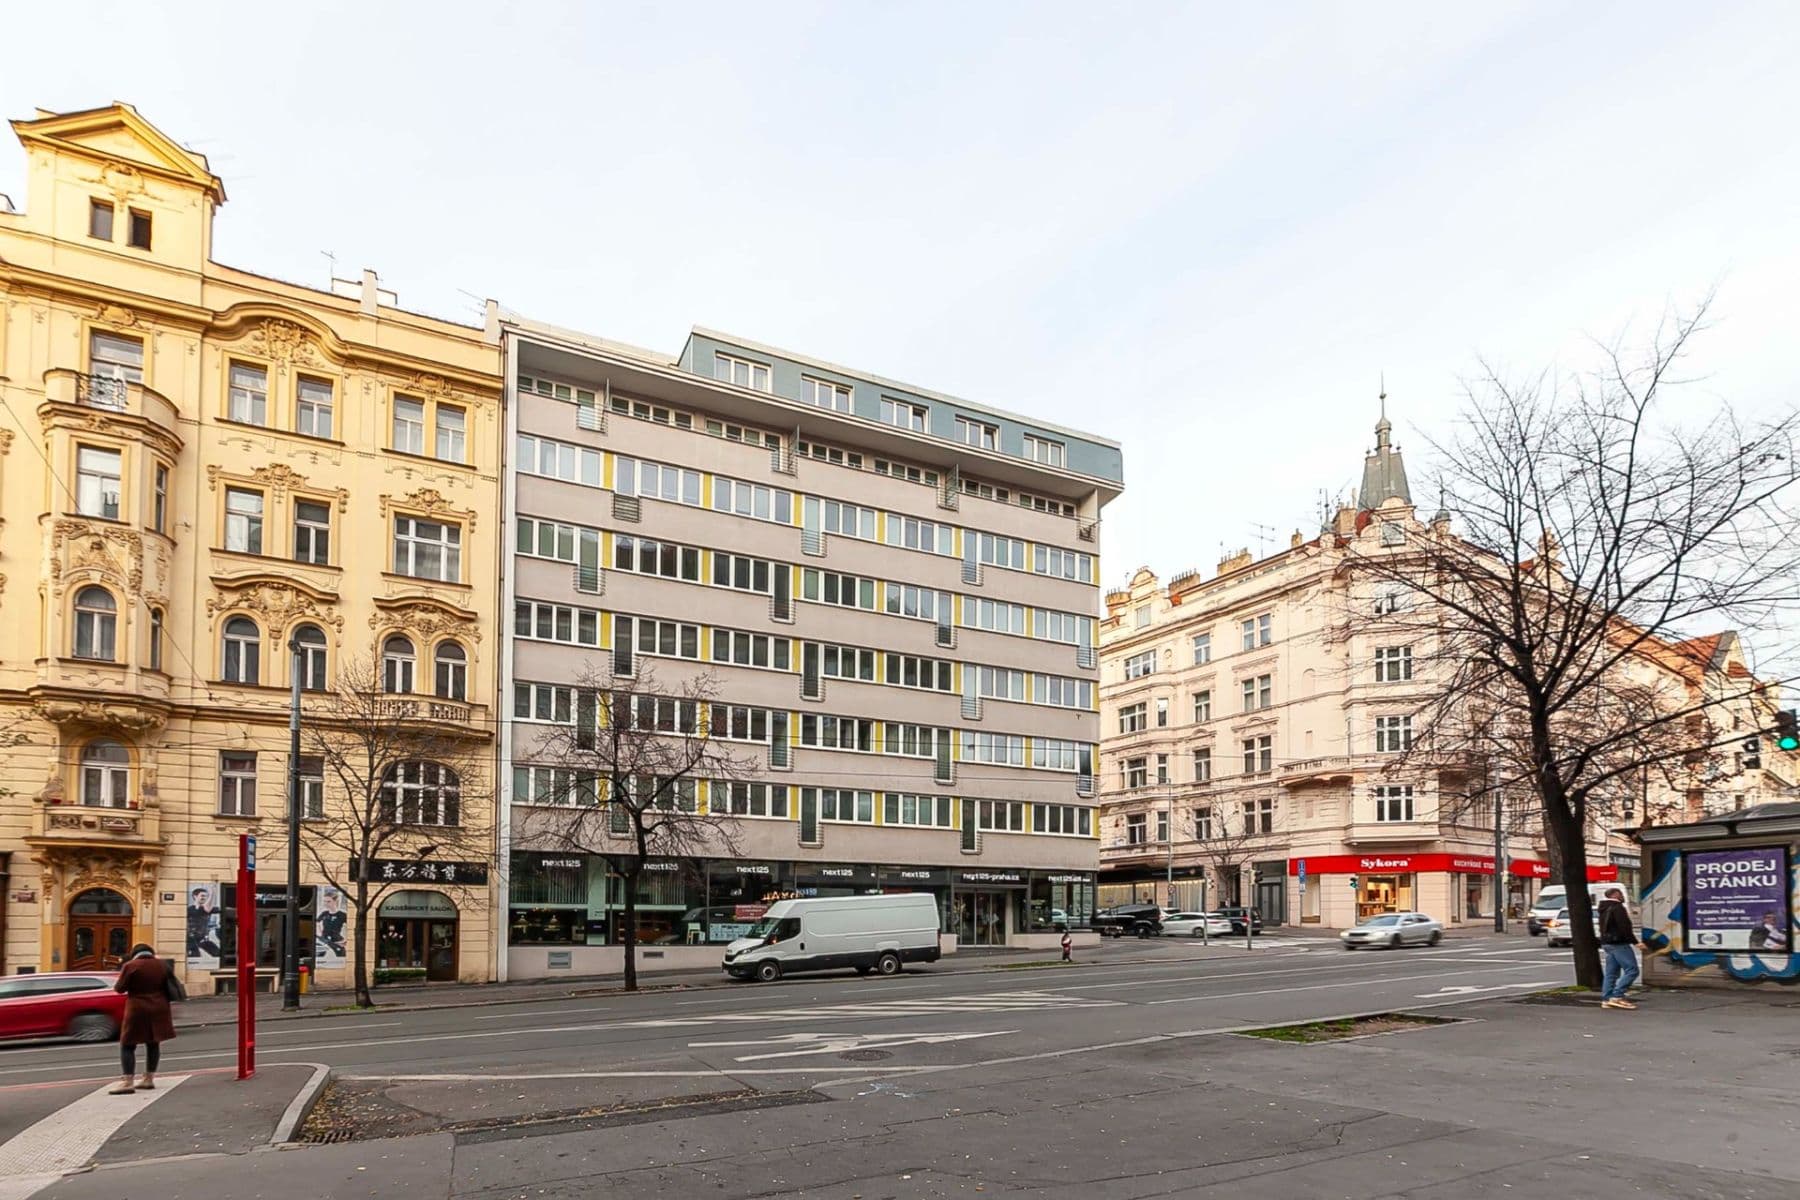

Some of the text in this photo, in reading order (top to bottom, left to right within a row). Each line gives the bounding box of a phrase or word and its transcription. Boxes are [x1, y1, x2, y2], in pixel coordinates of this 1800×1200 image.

[542, 859, 581, 868] next125
[643, 862, 679, 871] next125
[1360, 859, 1409, 870] Sykora
[1695, 860, 1776, 874] PRODEJ
[736, 865, 770, 874] next125
[822, 868, 853, 877] next125
[1695, 875, 1777, 889] STÁNKU
